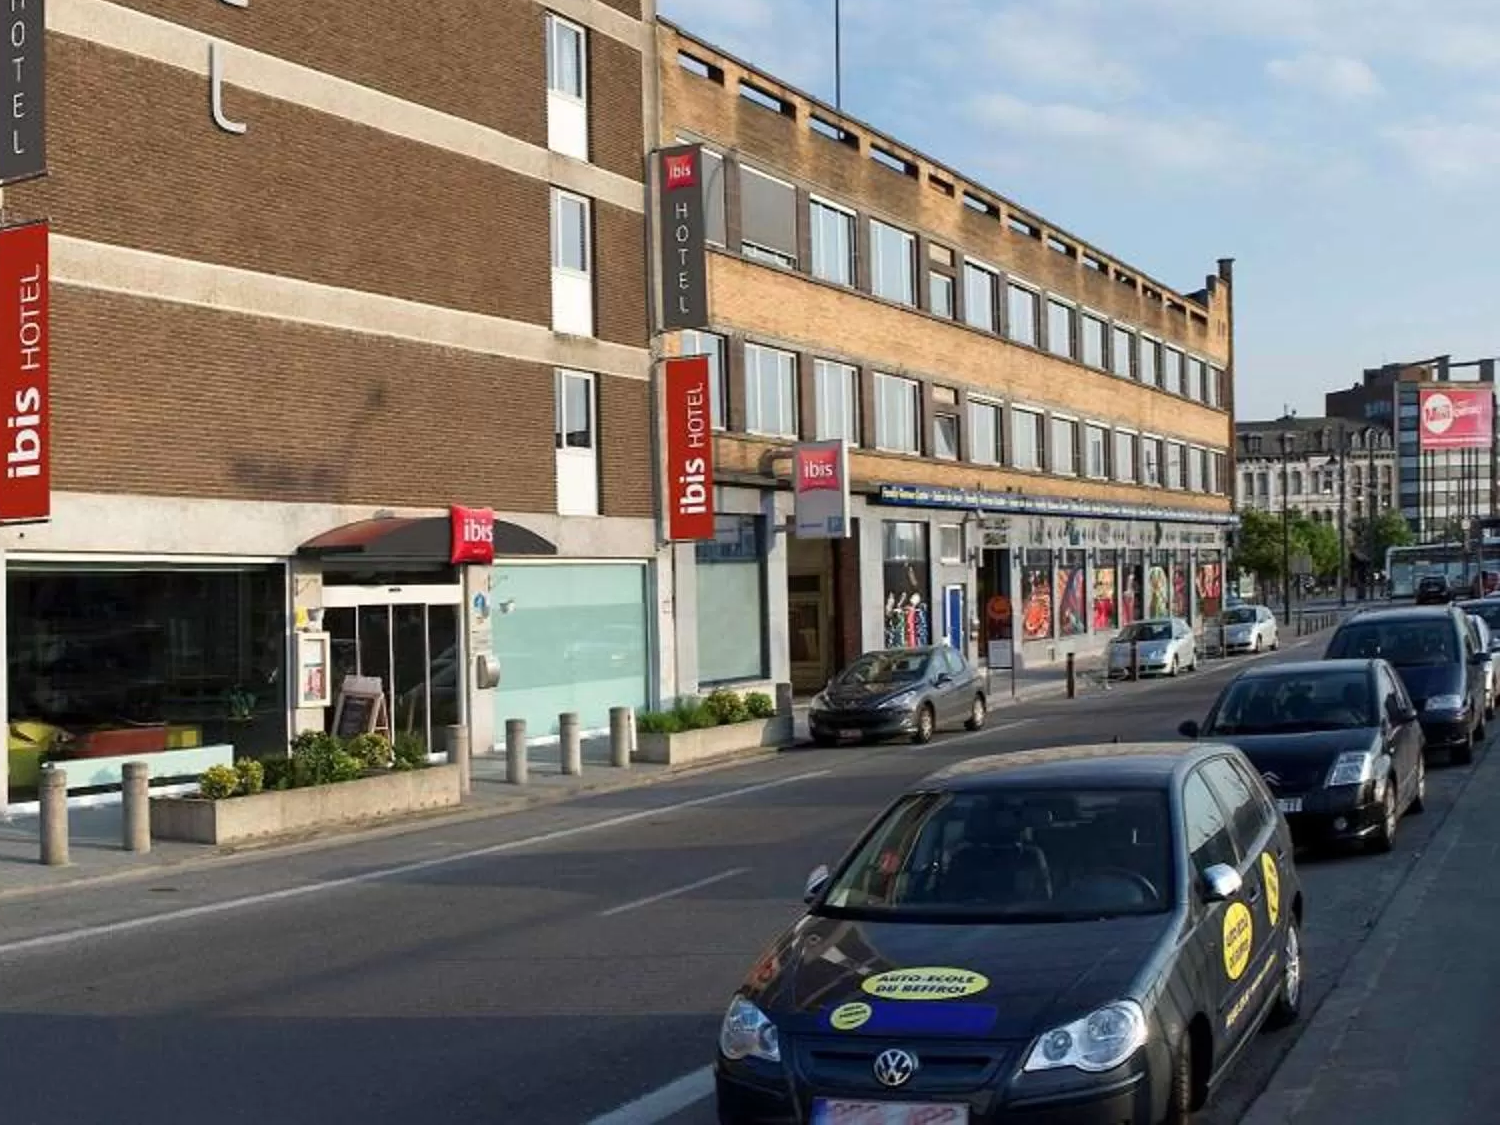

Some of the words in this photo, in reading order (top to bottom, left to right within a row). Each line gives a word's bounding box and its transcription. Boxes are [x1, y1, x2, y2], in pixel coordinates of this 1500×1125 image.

[669, 164, 691, 179] ibis
[676, 203, 689, 314] HOTEL
[20, 264, 41, 371] HOTEL
[8, 386, 40, 478] ibis
[688, 383, 704, 448] HOTEL
[680, 458, 706, 514] ibis
[804, 461, 833, 478] ibis
[464, 518, 493, 542] ibis
